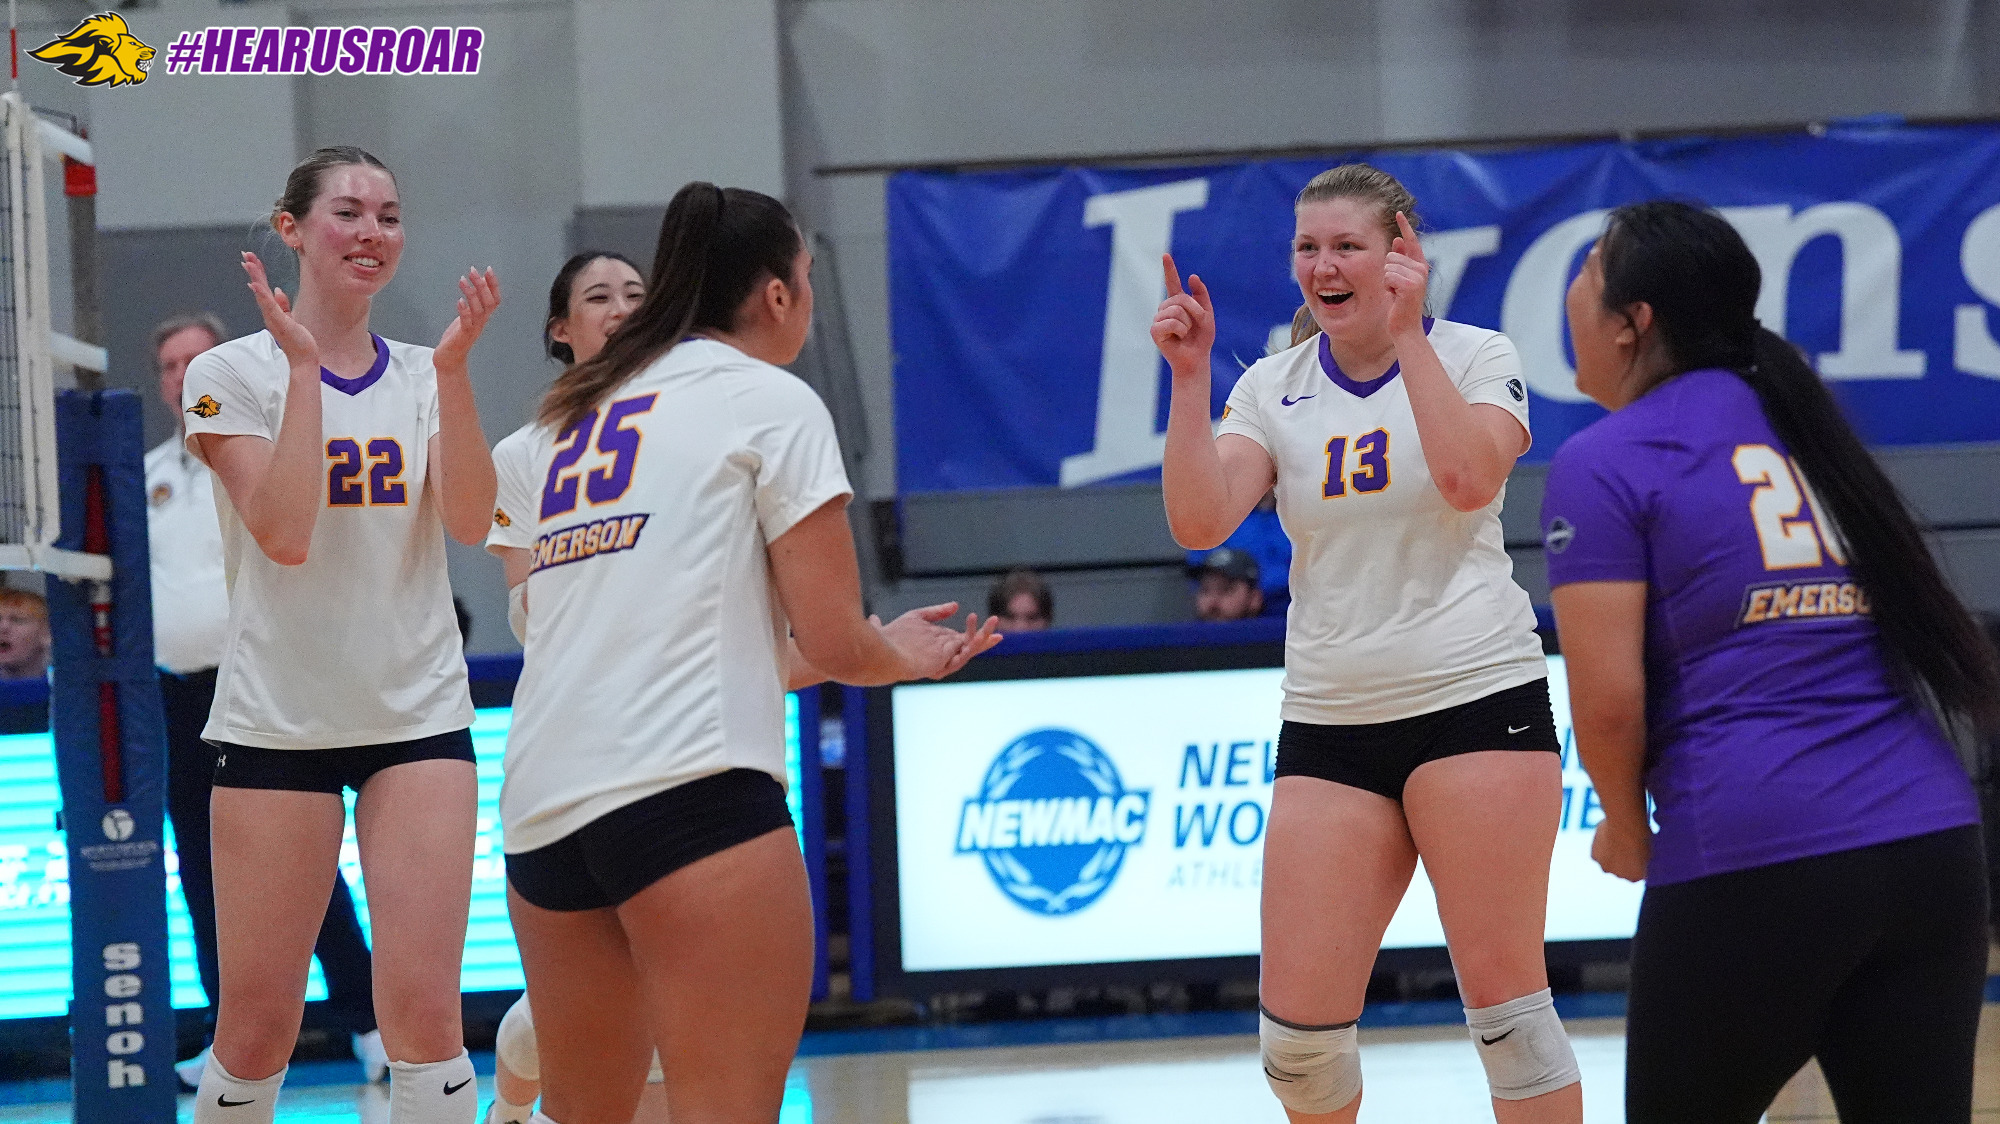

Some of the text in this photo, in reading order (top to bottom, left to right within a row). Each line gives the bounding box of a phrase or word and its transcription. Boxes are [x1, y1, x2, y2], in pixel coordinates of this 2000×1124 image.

[325, 437, 408, 507] 22
[539, 391, 661, 523] 25
[1322, 427, 1391, 500] 13
[1731, 444, 1848, 571] 2
[958, 793, 1147, 851] NEWMAC
[102, 942, 146, 1089] senoh
